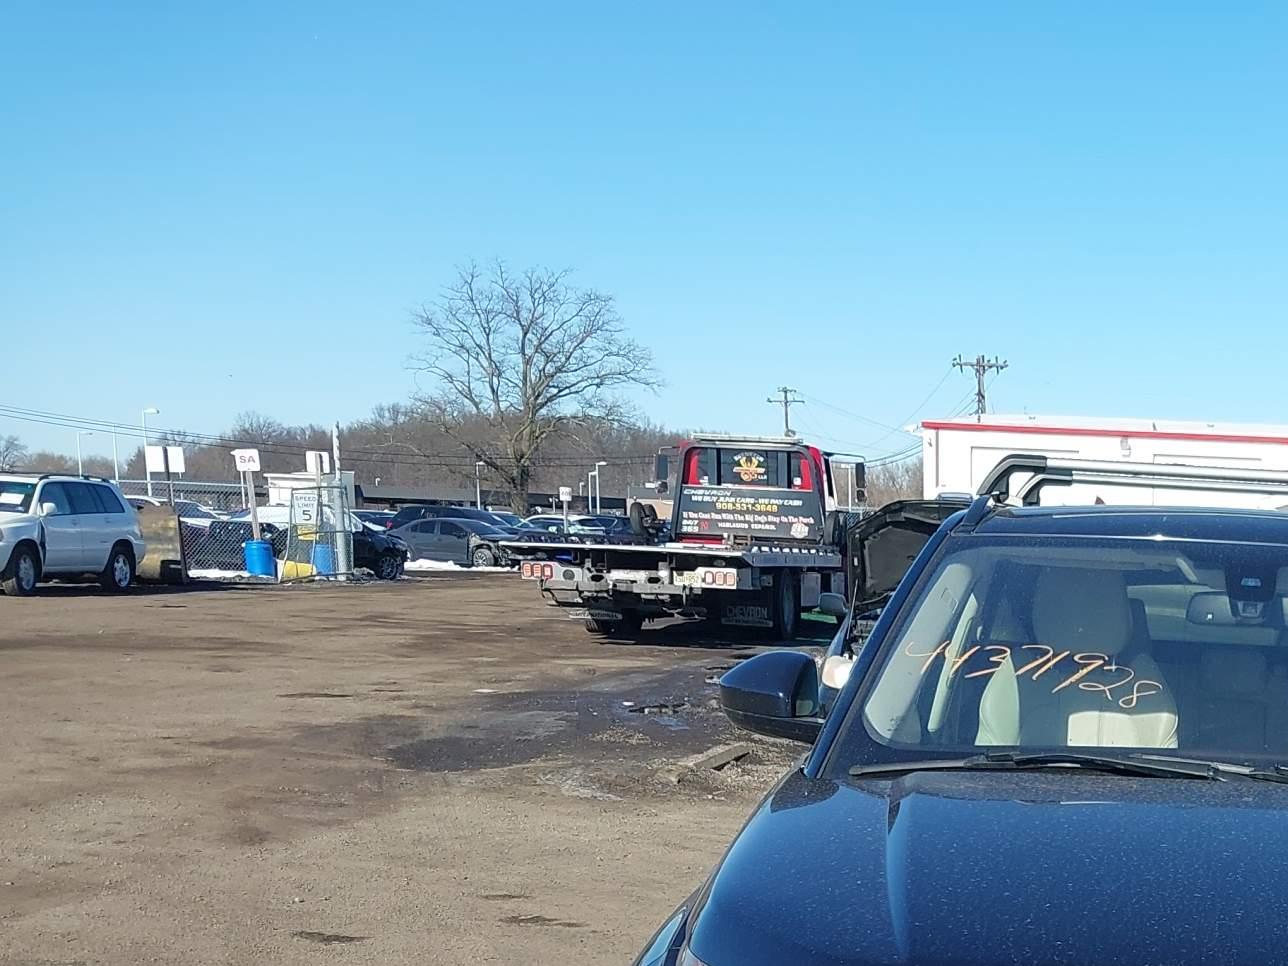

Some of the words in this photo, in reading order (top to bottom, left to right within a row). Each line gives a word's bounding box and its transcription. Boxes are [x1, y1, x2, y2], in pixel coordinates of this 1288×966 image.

[239, 455, 256, 464] SA
[683, 488, 732, 496] CHEVRON
[302, 509, 312, 521] 5
[905, 640, 1163, 709] 44371928
